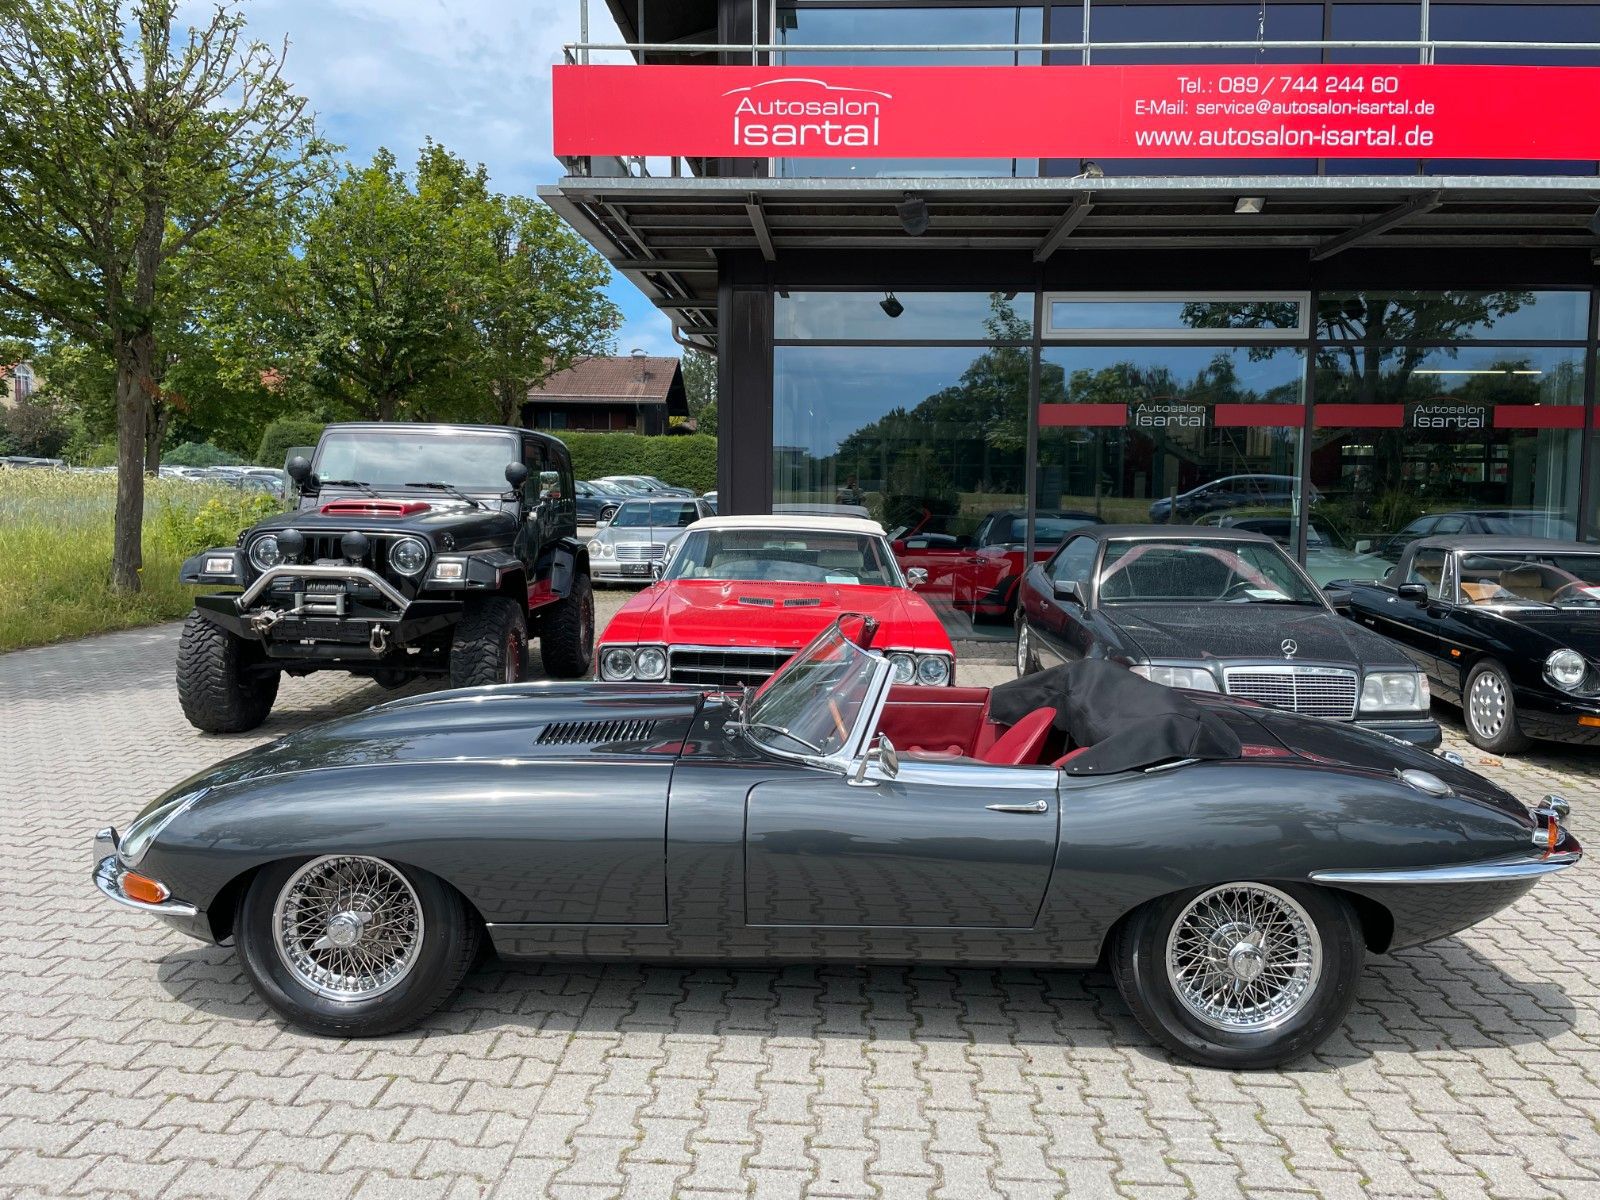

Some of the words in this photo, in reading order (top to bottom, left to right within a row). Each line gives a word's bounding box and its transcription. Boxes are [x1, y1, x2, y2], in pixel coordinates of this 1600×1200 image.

[1177, 76, 1213, 94] Tel.:
[1218, 76, 1259, 94] 089
[1279, 76, 1319, 93] 744
[1325, 76, 1365, 93] 244
[1371, 76, 1399, 93] 60
[734, 97, 880, 116] Autosalon
[1135, 99, 1188, 115] E-Mail:
[1195, 99, 1435, 115] service@autosalon-isartal.de
[733, 116, 879, 146] Isartal
[1135, 124, 1434, 146] www.autosalon-isartal.de
[1136, 403, 1206, 413] Autosalon
[1414, 404, 1485, 414] Autosalon
[1135, 412, 1206, 427] Isartal
[1413, 413, 1485, 428] Isartal
